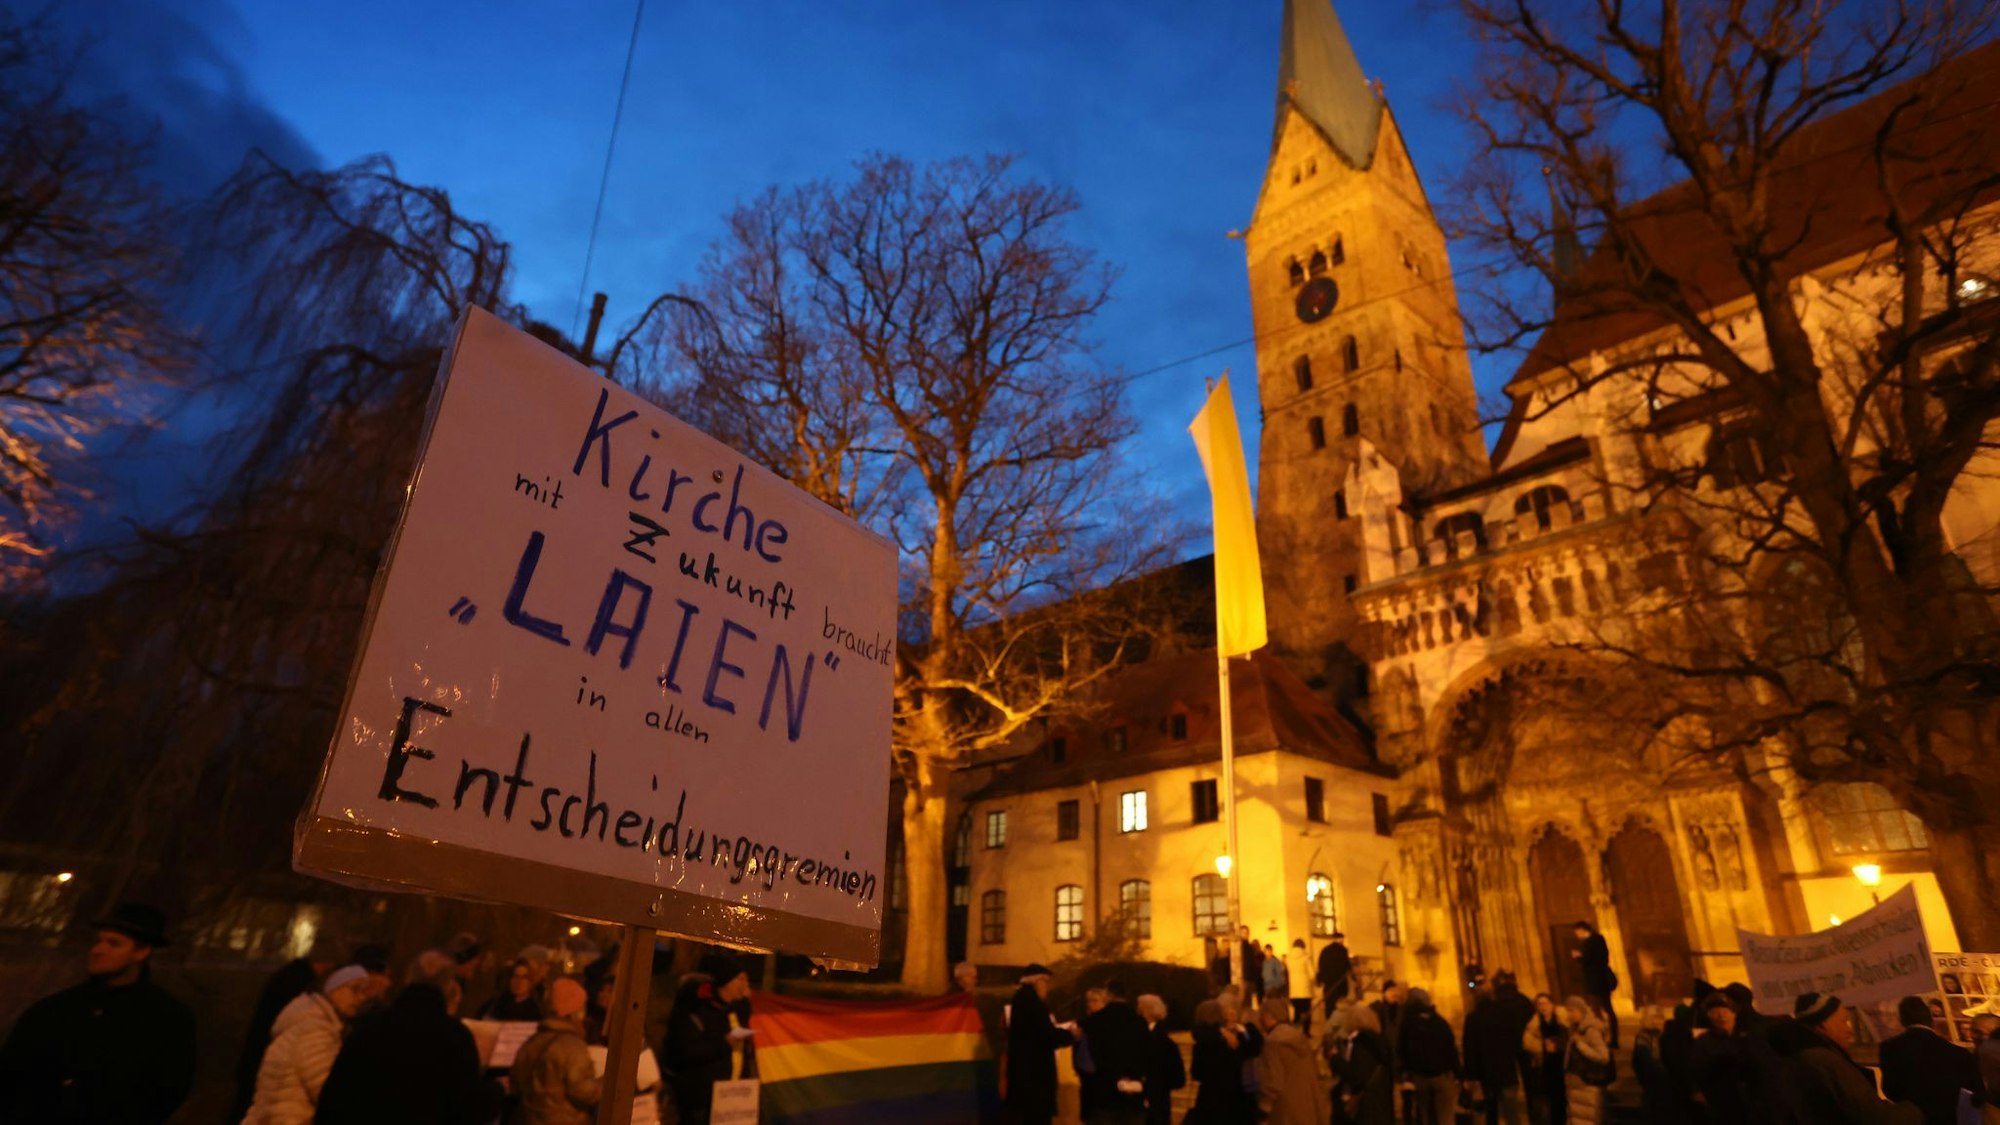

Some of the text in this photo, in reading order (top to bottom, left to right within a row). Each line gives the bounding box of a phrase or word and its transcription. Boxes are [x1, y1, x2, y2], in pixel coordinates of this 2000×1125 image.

[572, 388, 789, 563] Kirche
[514, 471, 892, 667] mit Zukunft braucht
[377, 697, 877, 900] Entscheidungsgremien
[576, 677, 709, 744] in allen
